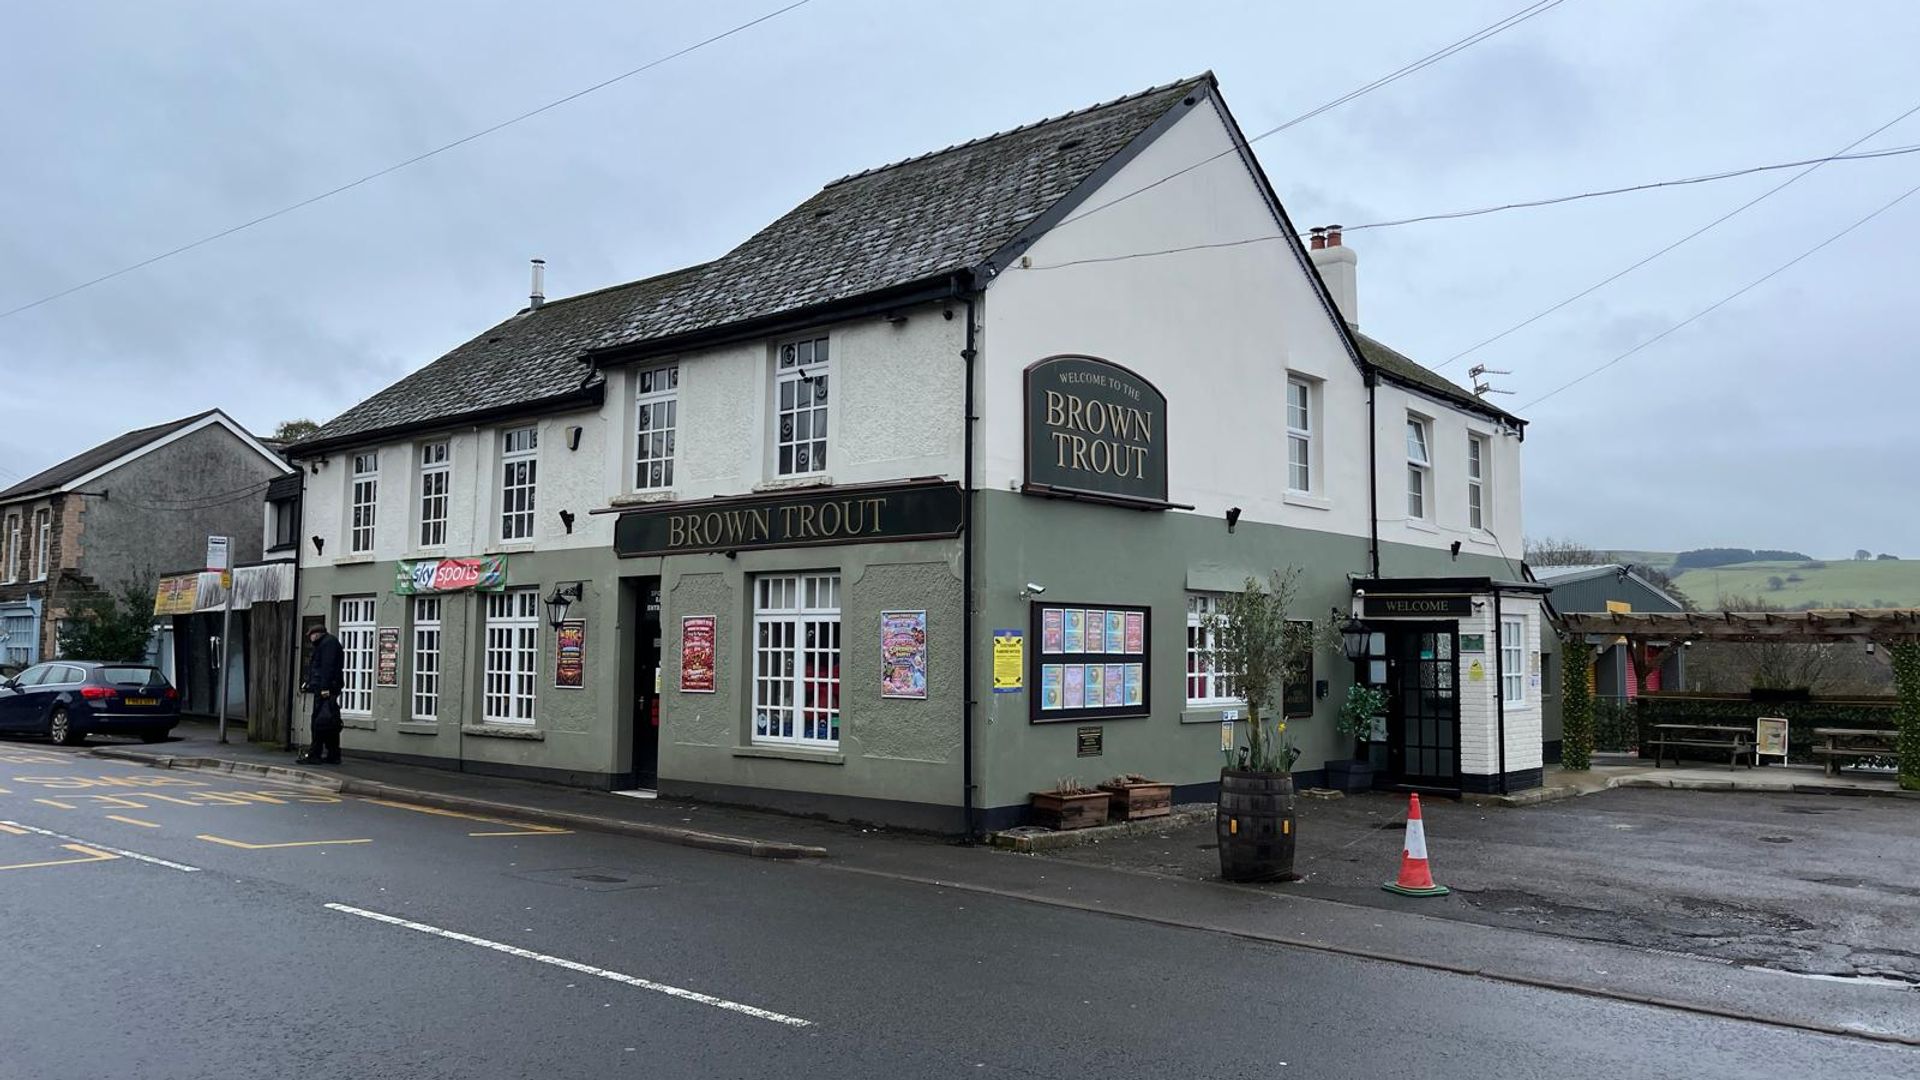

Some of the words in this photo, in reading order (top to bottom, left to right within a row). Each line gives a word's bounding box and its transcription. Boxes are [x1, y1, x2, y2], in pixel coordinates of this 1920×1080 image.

[1059, 371, 1107, 387] WELCOME
[1109, 378, 1121, 390] TO
[1123, 383, 1141, 401] THE
[1045, 389, 1153, 444] BROWN
[1051, 431, 1149, 480] TROUT
[667, 507, 773, 547] BROWN
[779, 498, 888, 538] TROUT
[413, 562, 436, 587] sky
[437, 562, 480, 585] sports
[1385, 600, 1449, 612] WELCOME
